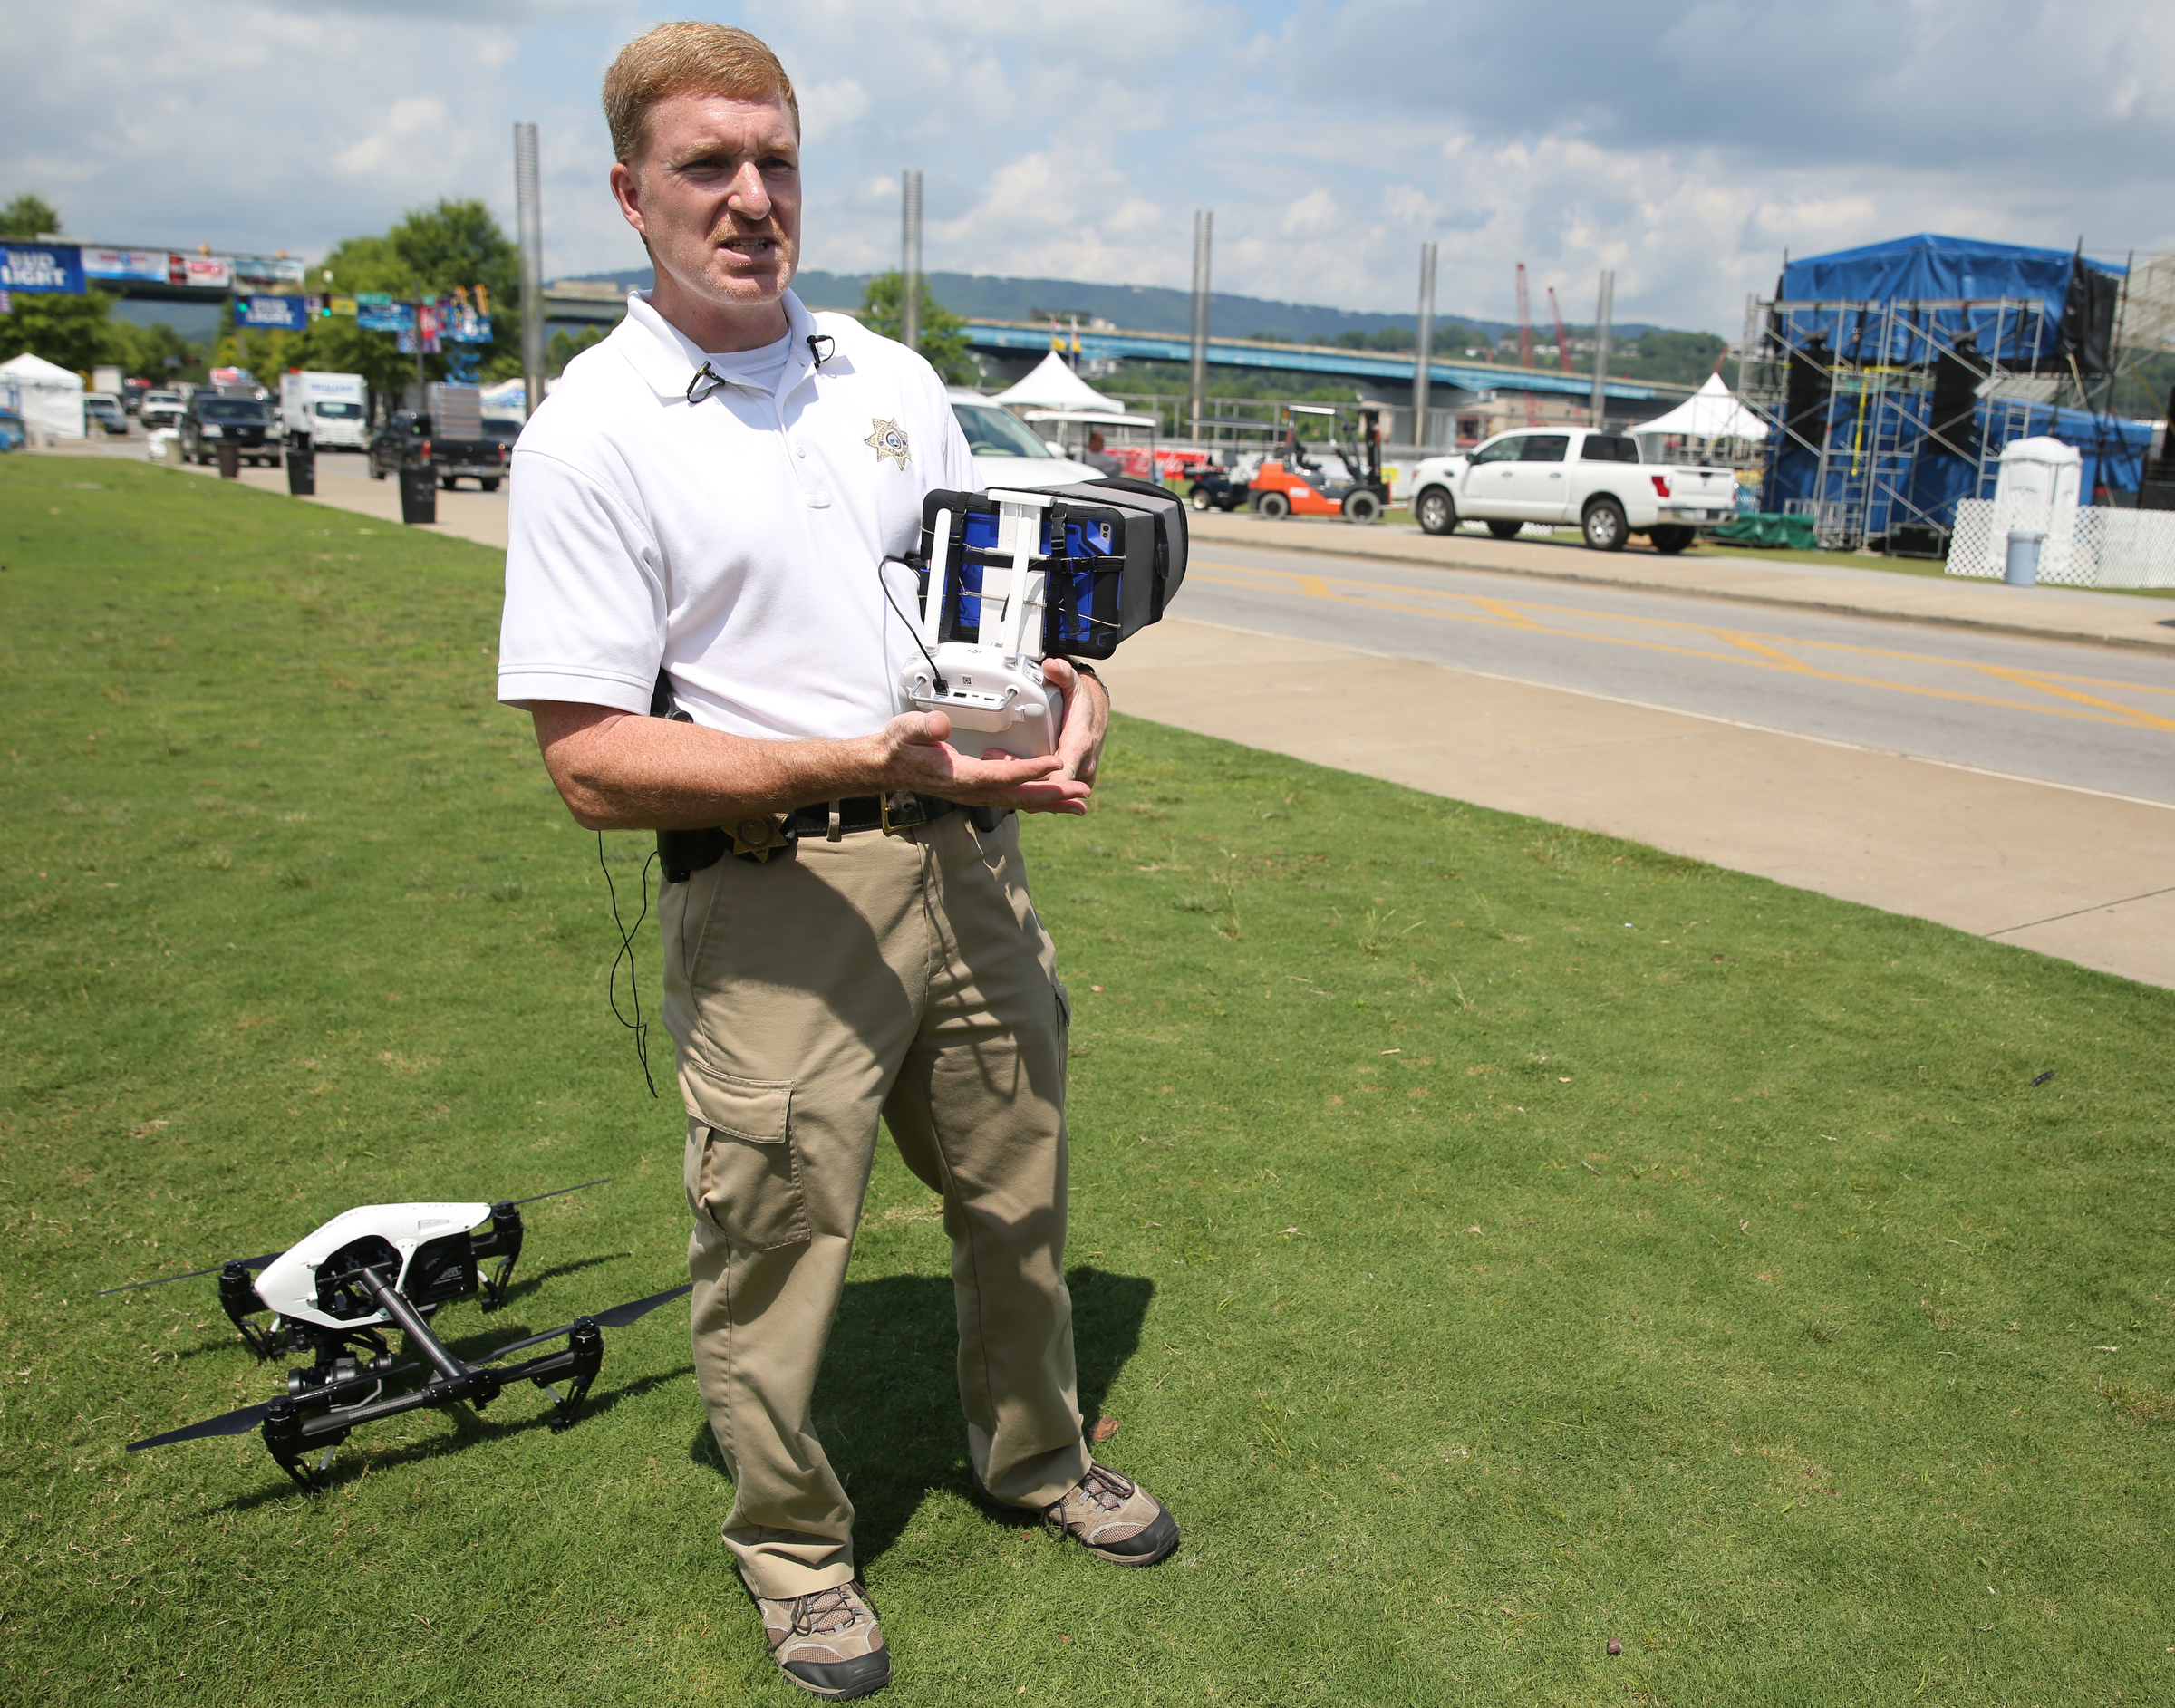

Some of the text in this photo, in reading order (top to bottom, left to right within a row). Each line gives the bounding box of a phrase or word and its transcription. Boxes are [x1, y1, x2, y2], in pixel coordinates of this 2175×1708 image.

[7, 250, 57, 271] BUD
[1, 265, 67, 286] LIGHT
[251, 297, 289, 314] BUD
[245, 310, 295, 325] LIGHT
